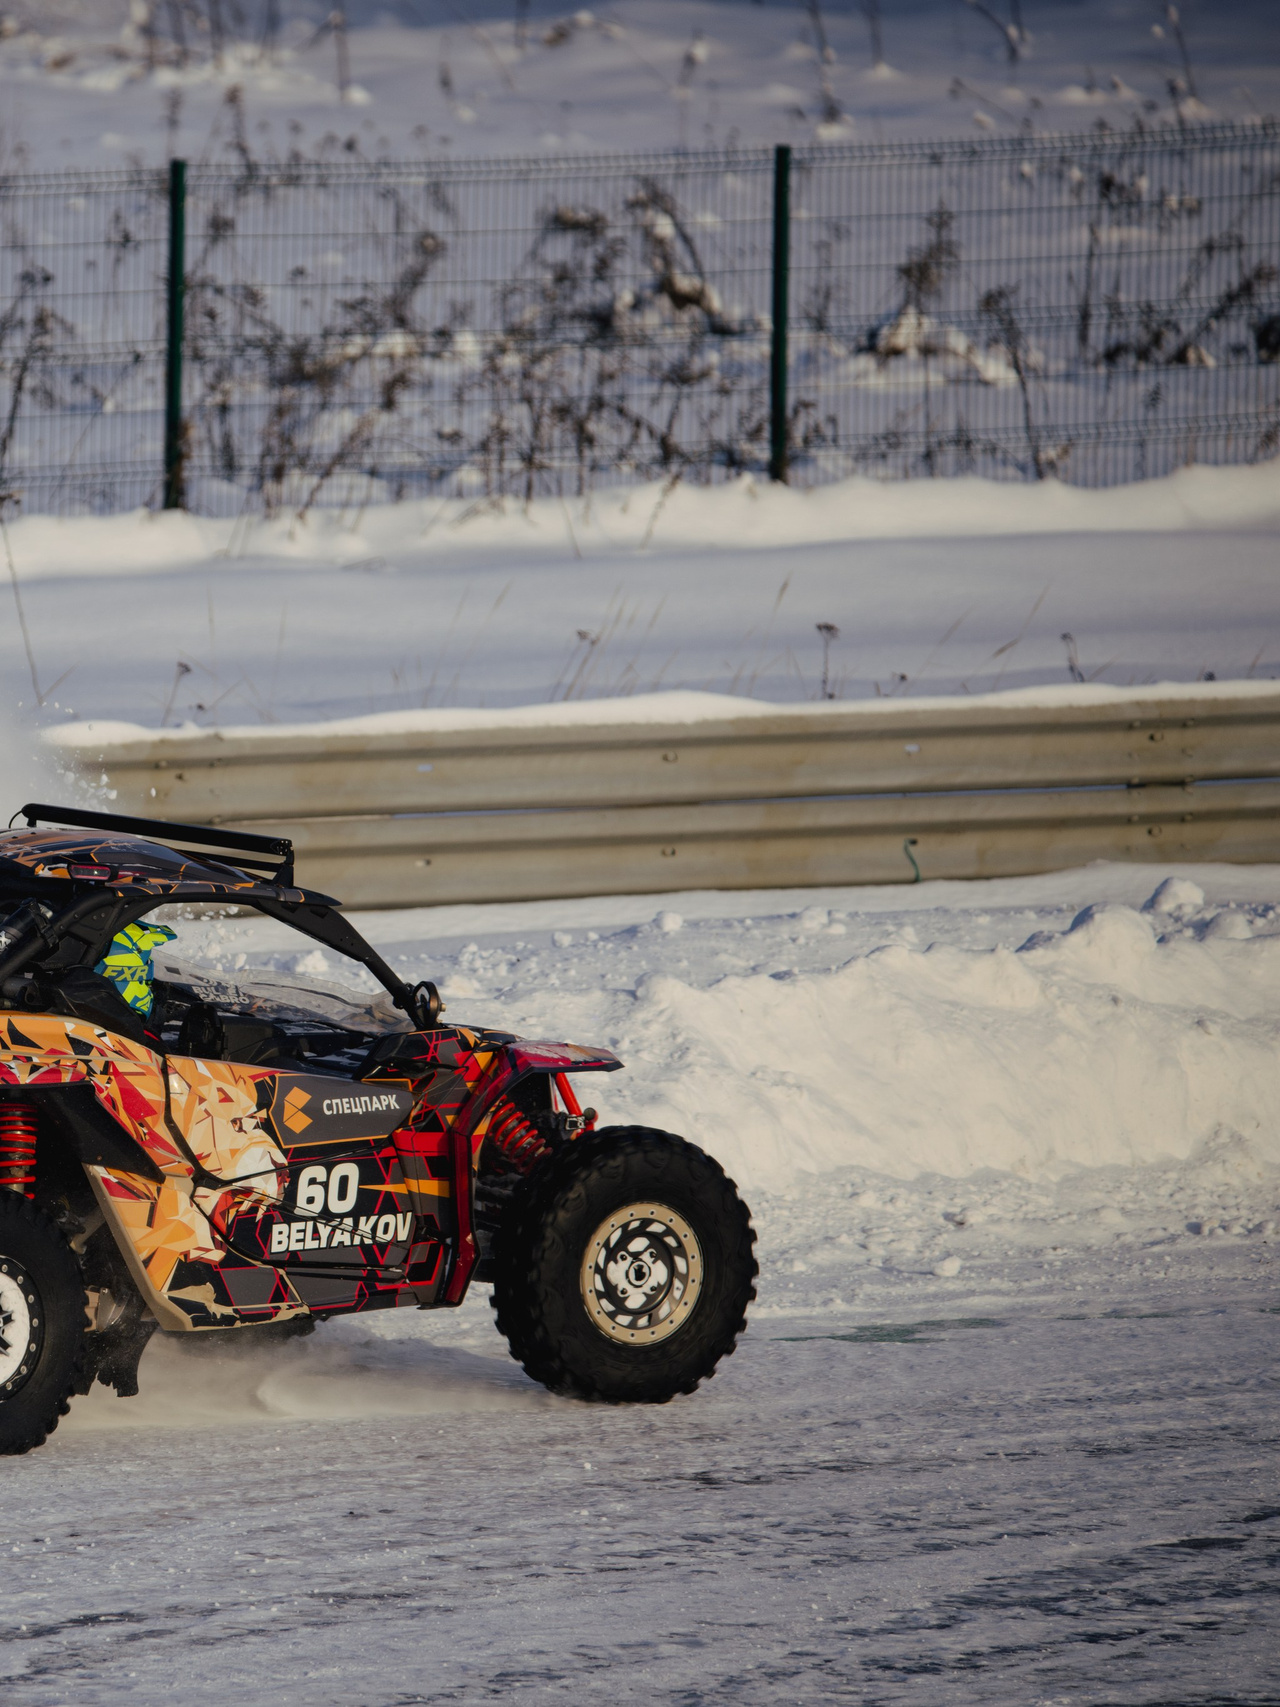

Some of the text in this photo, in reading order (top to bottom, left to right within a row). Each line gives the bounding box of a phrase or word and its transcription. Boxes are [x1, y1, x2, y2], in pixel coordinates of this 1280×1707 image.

[102, 966, 149, 982] FXR
[322, 1094, 400, 1115] СПЕЦПАРК
[293, 1162, 360, 1217] 60
[270, 1211, 413, 1253] BELYAKOV
